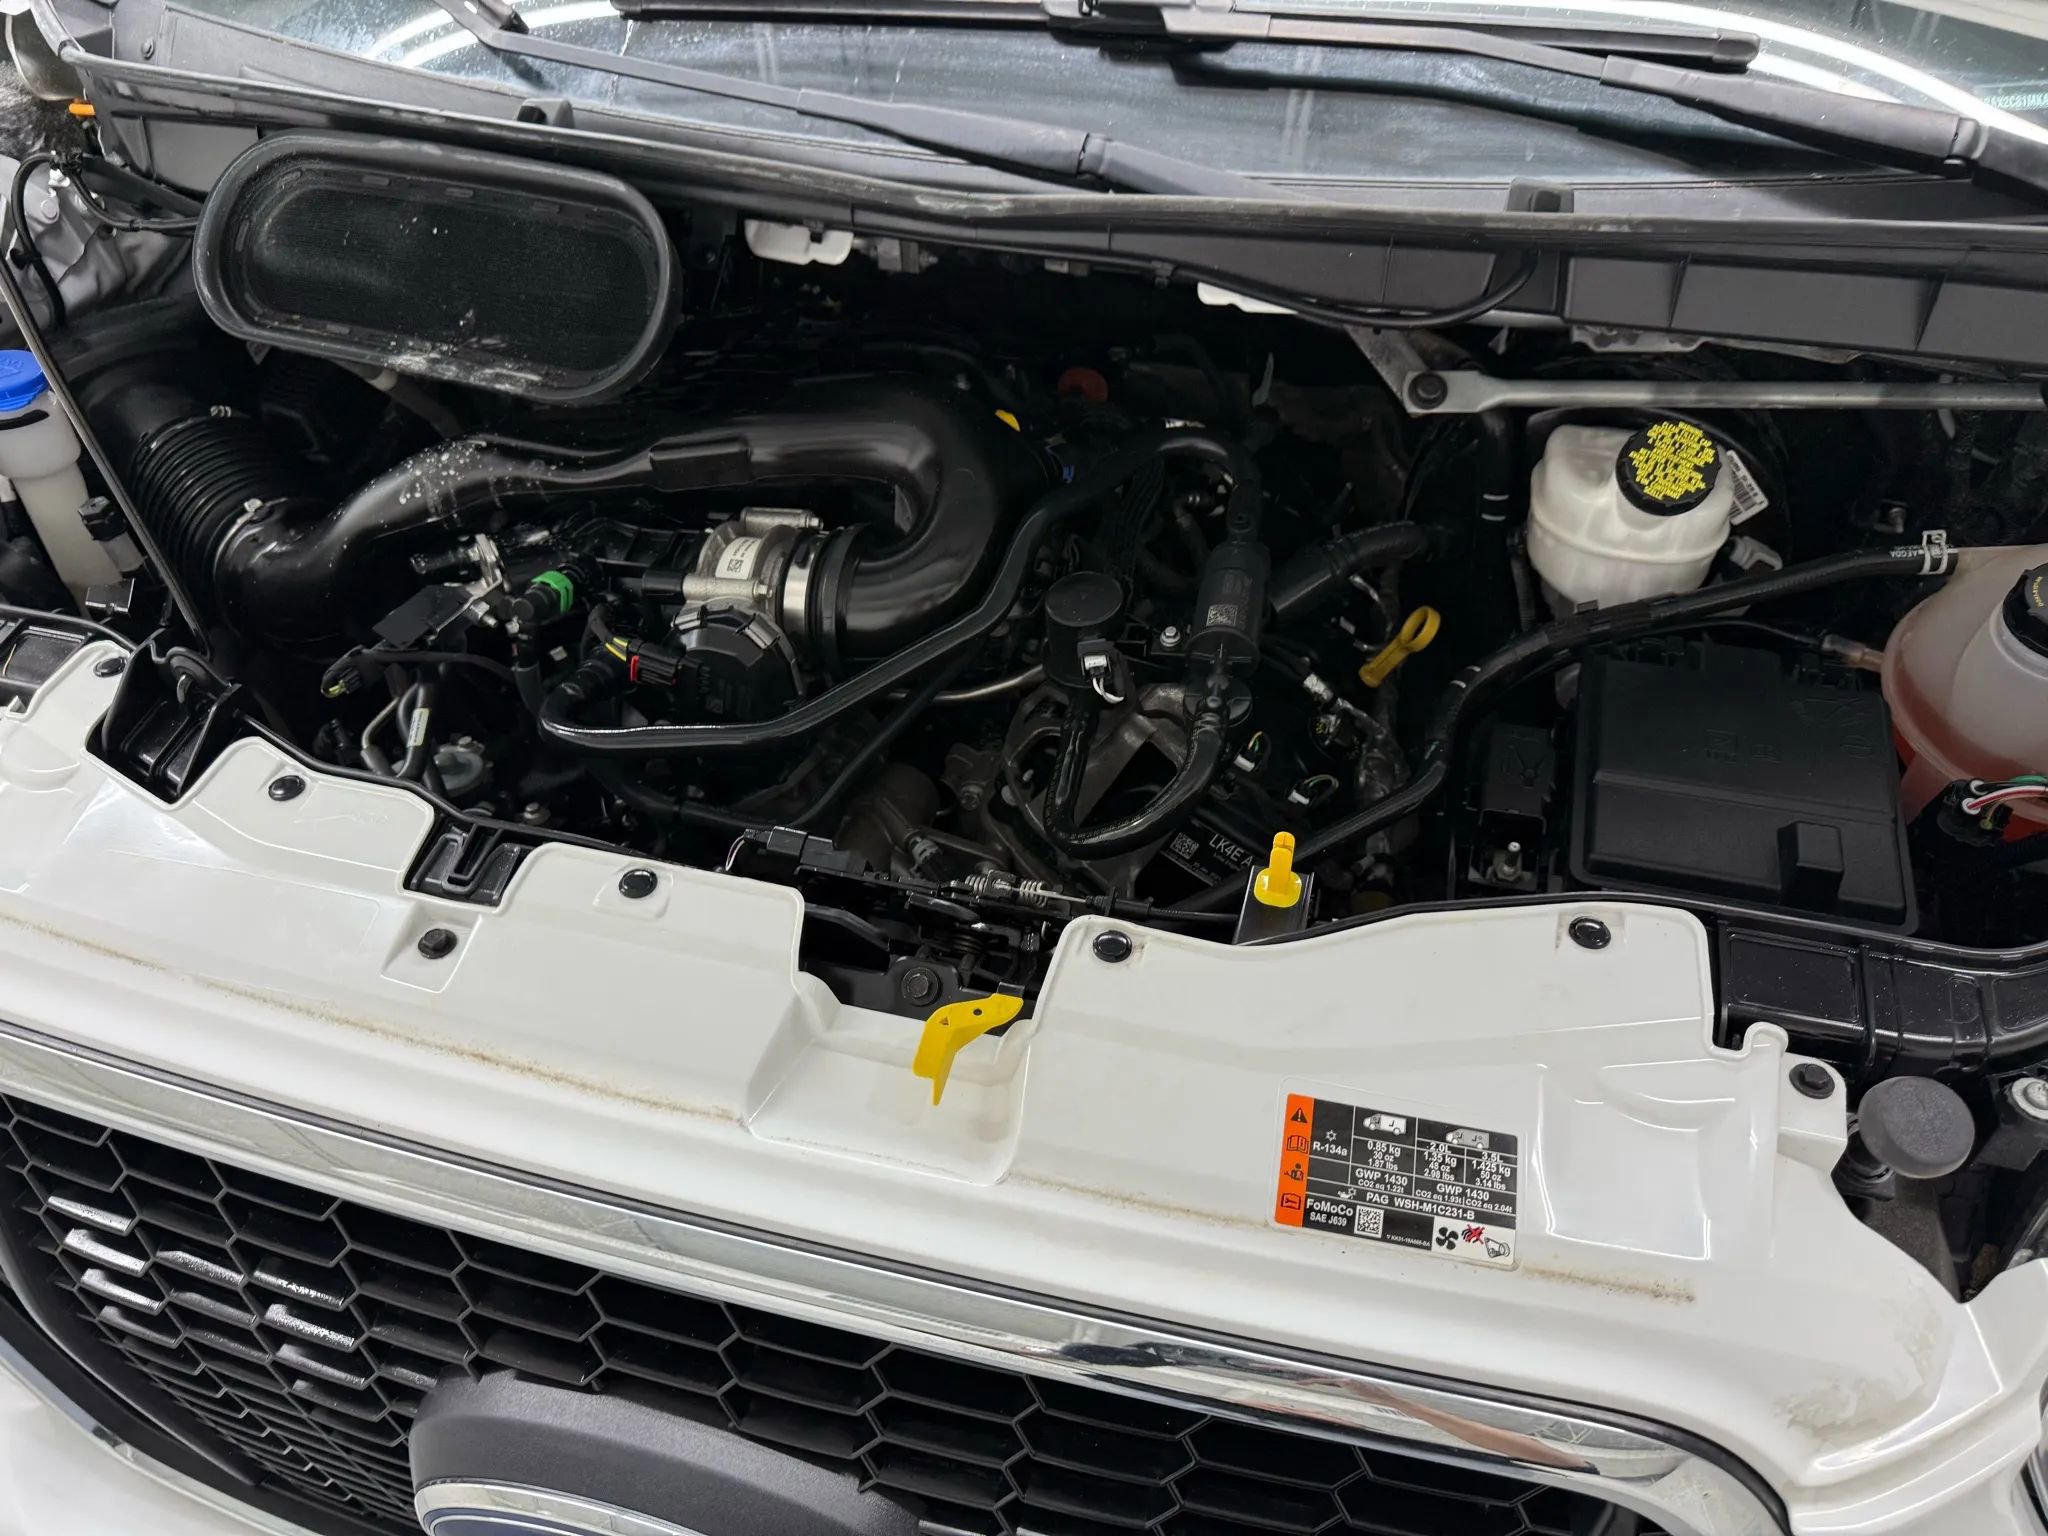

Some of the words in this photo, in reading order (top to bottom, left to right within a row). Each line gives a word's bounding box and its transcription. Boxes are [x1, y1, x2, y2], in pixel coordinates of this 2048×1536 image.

[1209, 833, 1242, 862] LK4E
[1313, 1142, 1347, 1156] R-134a
[1367, 1141, 1388, 1153] 0.85
[1389, 1145, 1401, 1158] kg
[1429, 1142, 1451, 1154] 2.0L
[1373, 1151, 1383, 1160] 30
[1384, 1153, 1394, 1162] oz
[1423, 1151, 1444, 1163] 1.35
[1445, 1156, 1457, 1167] kg
[1368, 1158, 1385, 1168] 1.87
[1386, 1161, 1398, 1170] lbs
[1429, 1162, 1439, 1170] 48
[1440, 1164, 1450, 1172] oz
[1472, 1160, 1497, 1173] 1.425
[1498, 1165, 1511, 1177] kg
[1356, 1168, 1381, 1181] GWP
[1384, 1172, 1408, 1186] 1430
[1423, 1167, 1440, 1177] 2.98
[1441, 1170, 1454, 1181] lbs
[1480, 1170, 1491, 1180] 50
[1492, 1173, 1502, 1181] oz
[1358, 1179, 1375, 1188] CO2
[1376, 1183, 1385, 1191] eq
[1475, 1177, 1492, 1188] 3.14
[1493, 1180, 1506, 1191] lbs
[1416, 1189, 1431, 1198] CO2
[1436, 1183, 1463, 1196] GWP
[1465, 1187, 1489, 1200] 1430
[1306, 1199, 1353, 1217] FoMoCo
[1366, 1191, 1389, 1204] PAG
[1394, 1197, 1475, 1220] WSH-M1C231-B
[1465, 1198, 1482, 1207] CO2
[1310, 1213, 1326, 1223] SAE
[1328, 1215, 1347, 1227] J639
